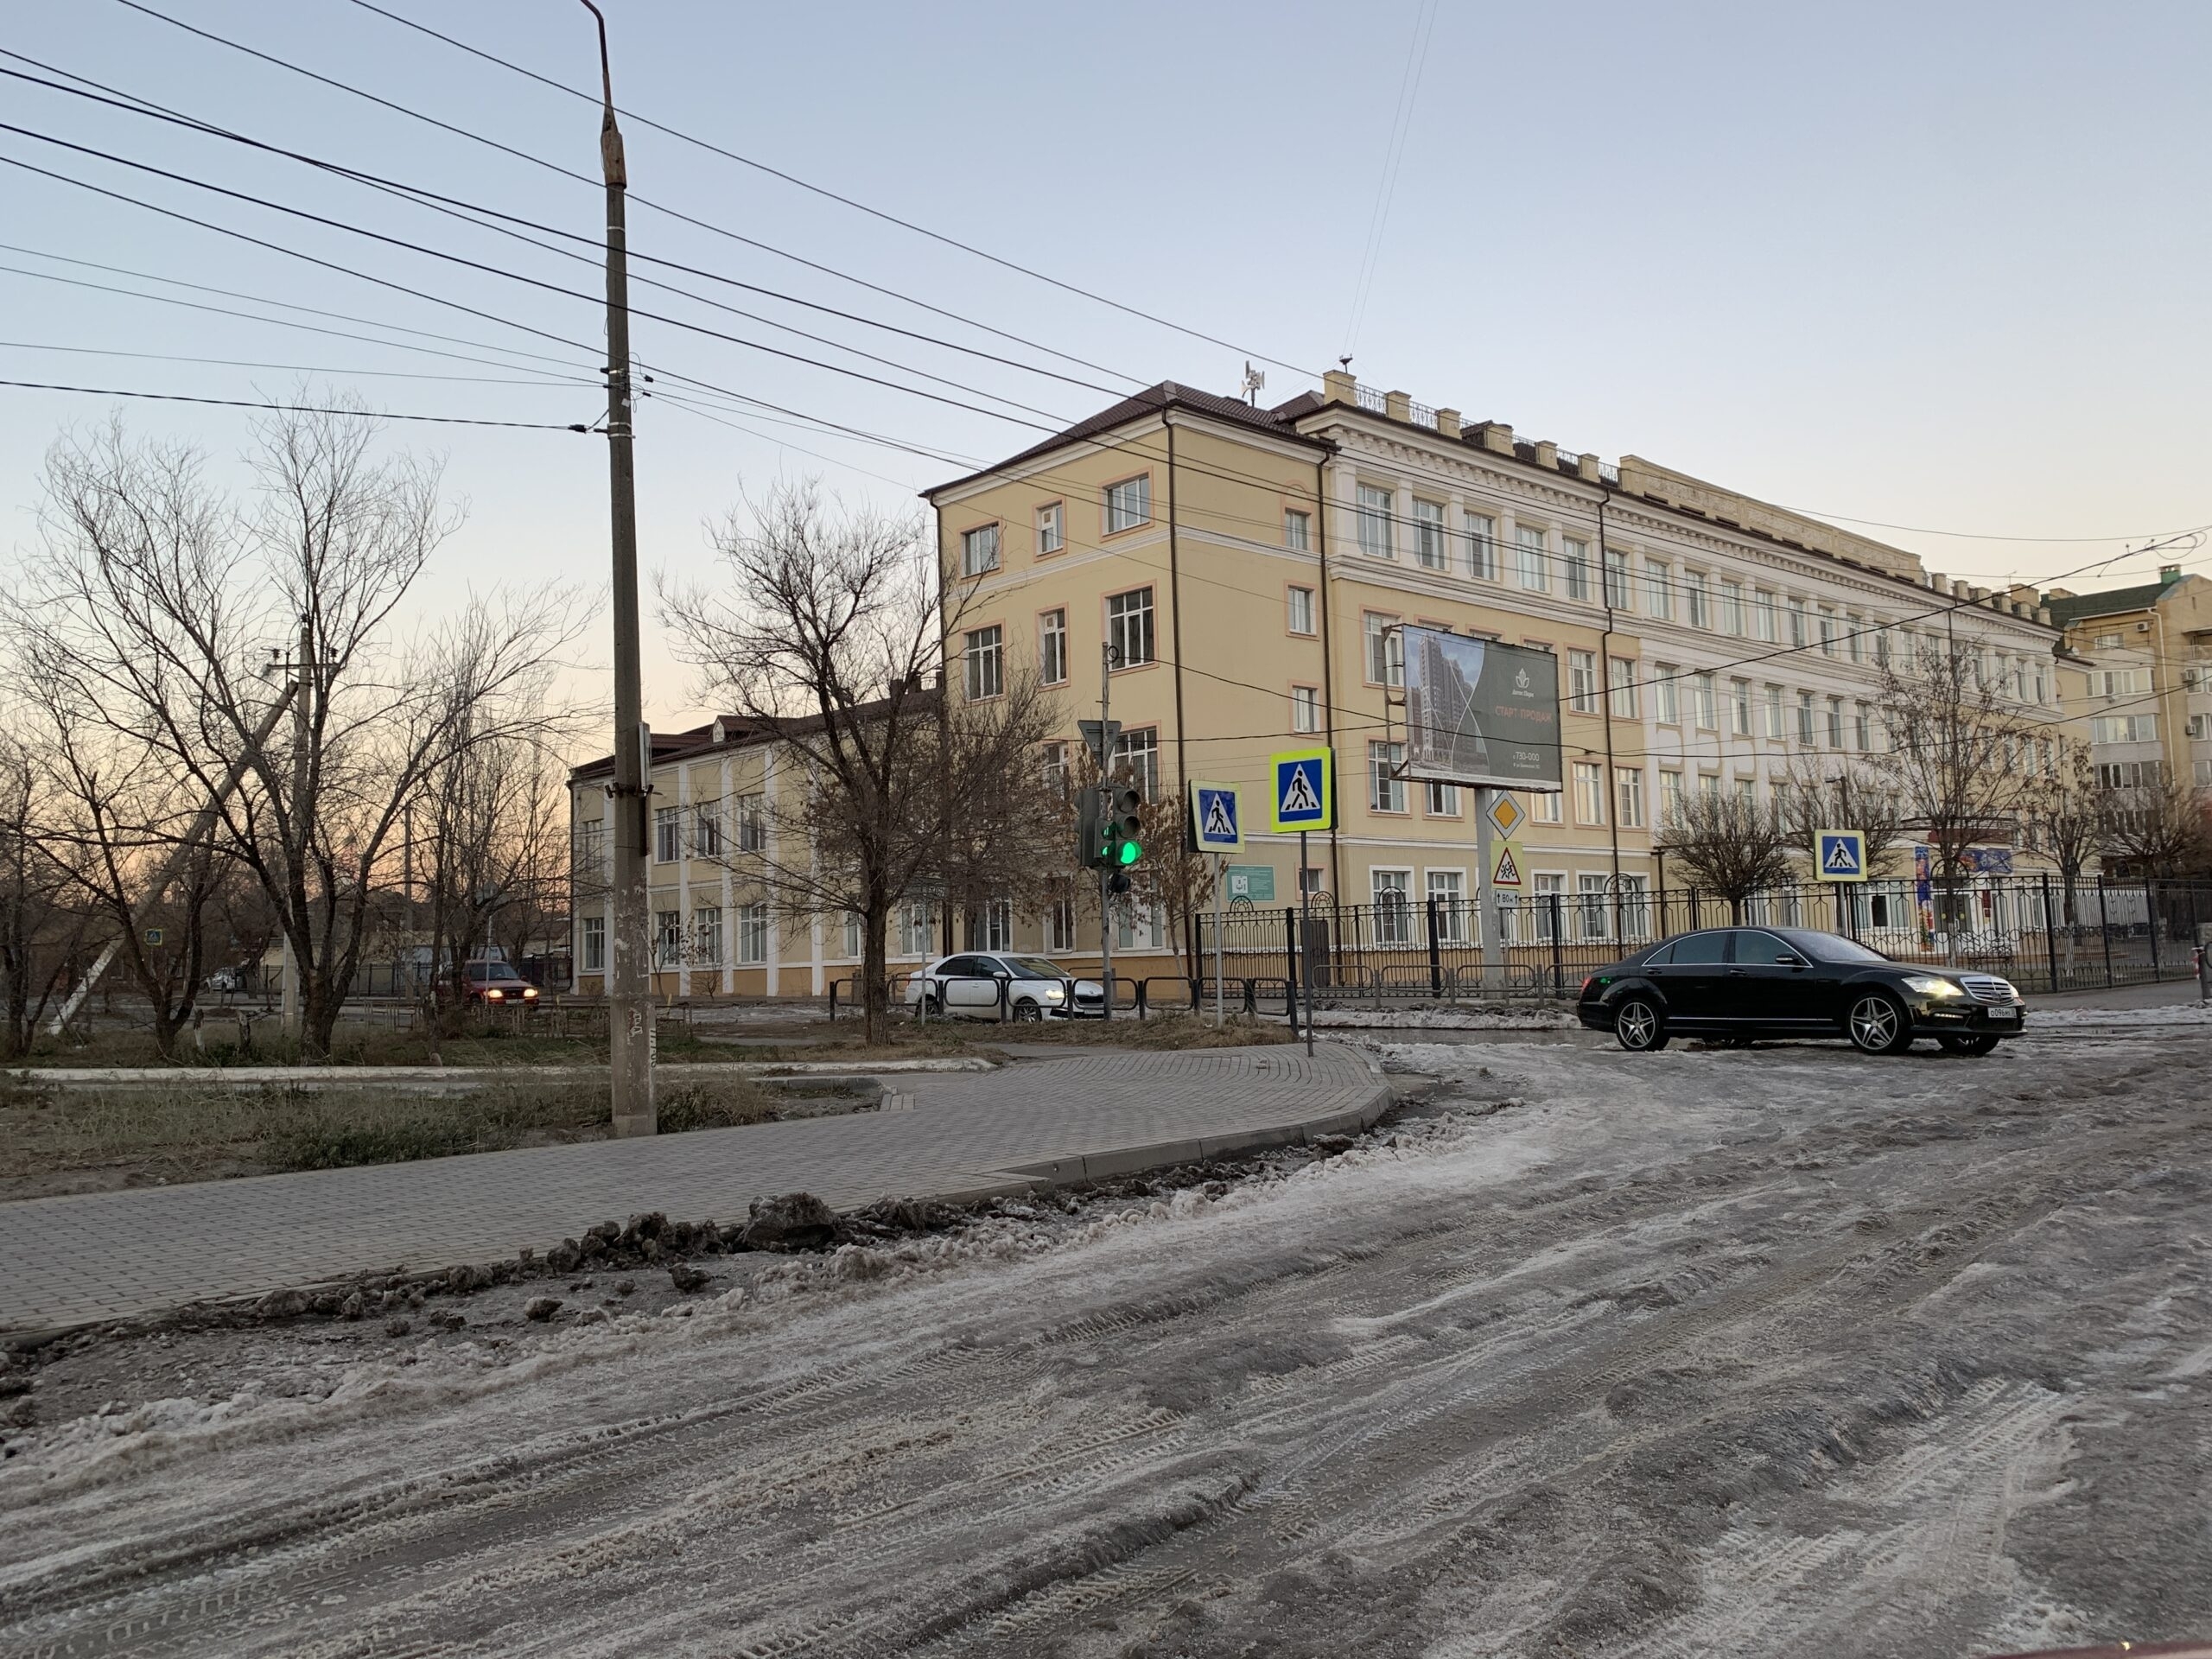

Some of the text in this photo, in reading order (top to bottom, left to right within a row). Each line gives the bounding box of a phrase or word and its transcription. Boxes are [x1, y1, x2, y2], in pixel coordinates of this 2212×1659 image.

[1495, 705, 1552, 723] СТАРТ ПРОДАЖ
[1515, 751, 1540, 761] 730-000
